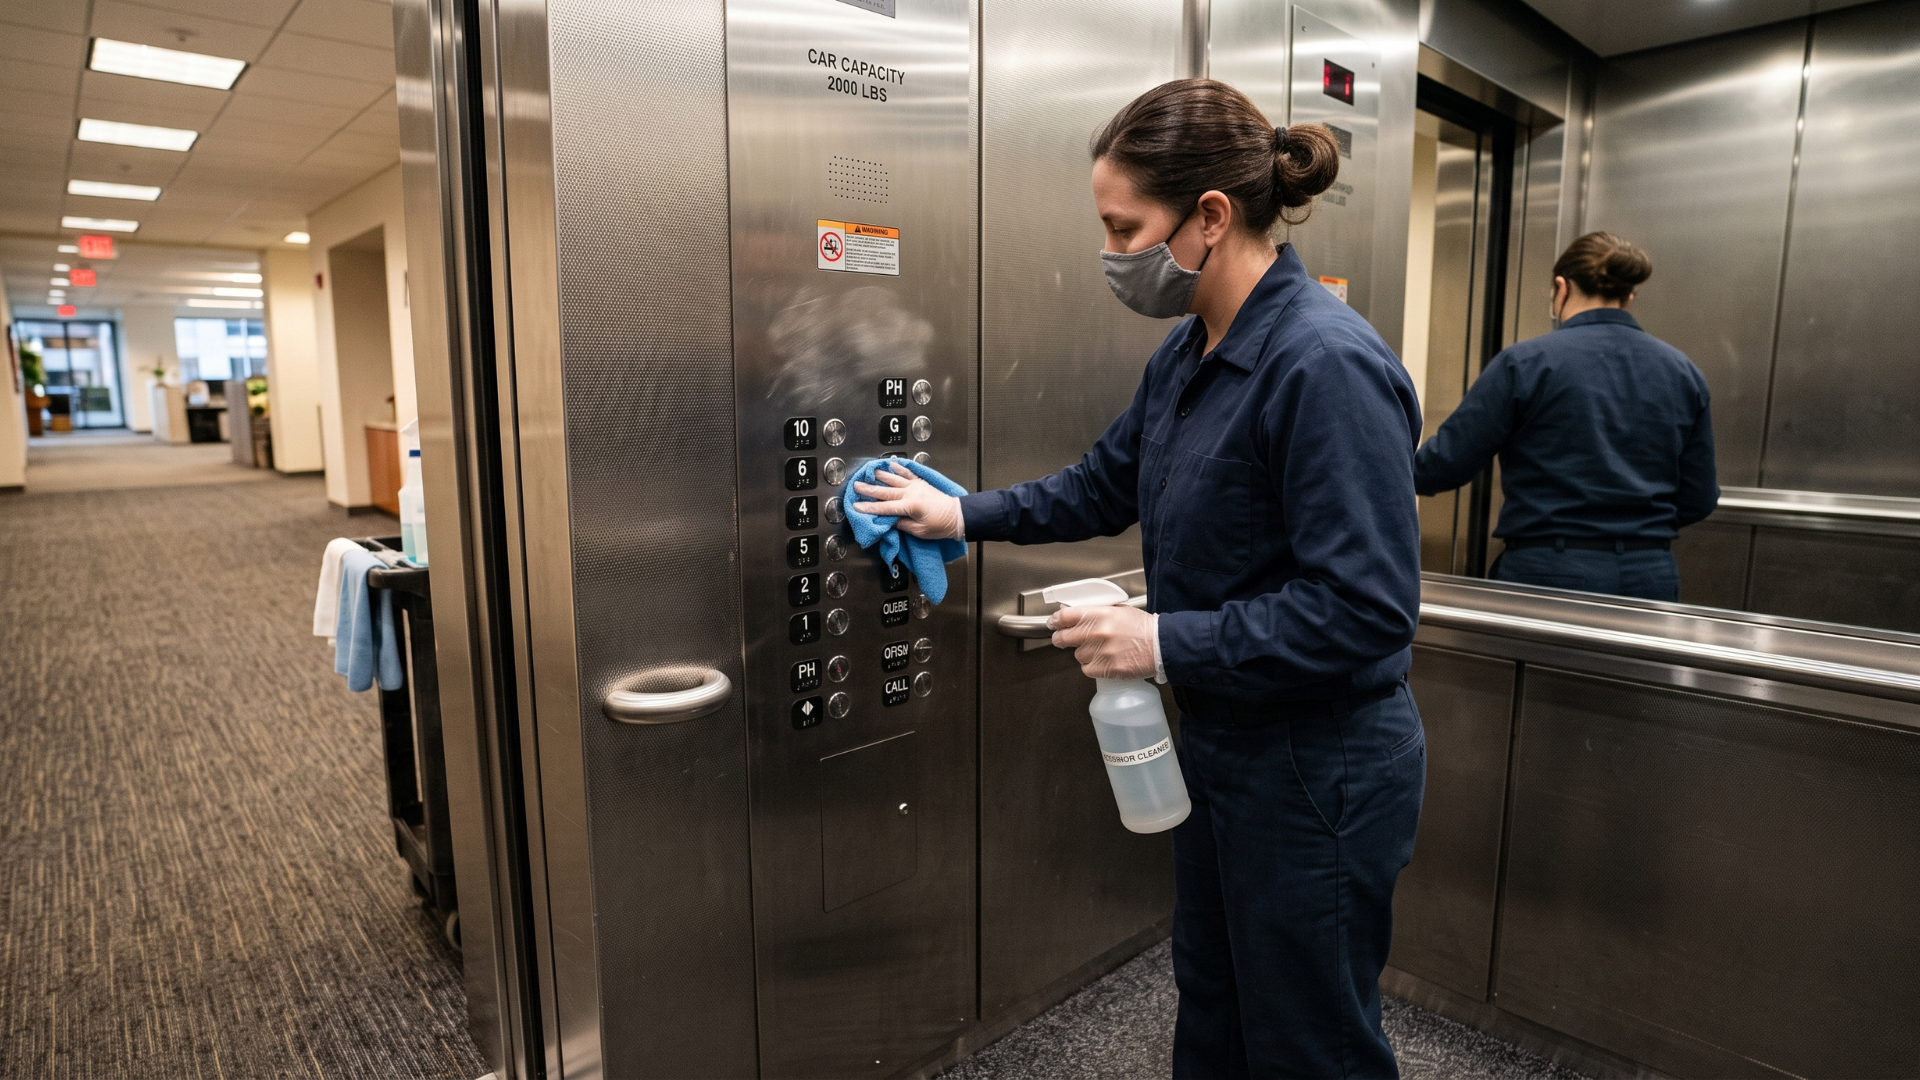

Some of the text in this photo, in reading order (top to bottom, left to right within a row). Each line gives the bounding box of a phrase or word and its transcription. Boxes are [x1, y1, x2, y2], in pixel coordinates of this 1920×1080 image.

[808, 48, 905, 85] CAR CAPACITY
[827, 75, 887, 102] 2000 LBS
[886, 380, 902, 395] PH
[793, 419, 809, 437] 10
[889, 417, 899, 433] G
[798, 459, 807, 476] 6
[799, 498, 808, 516] 4
[800, 538, 808, 554] 5
[801, 576, 809, 593] 2
[802, 615, 808, 630] 1
[798, 662, 816, 679] PH
[885, 679, 908, 694] CALL
